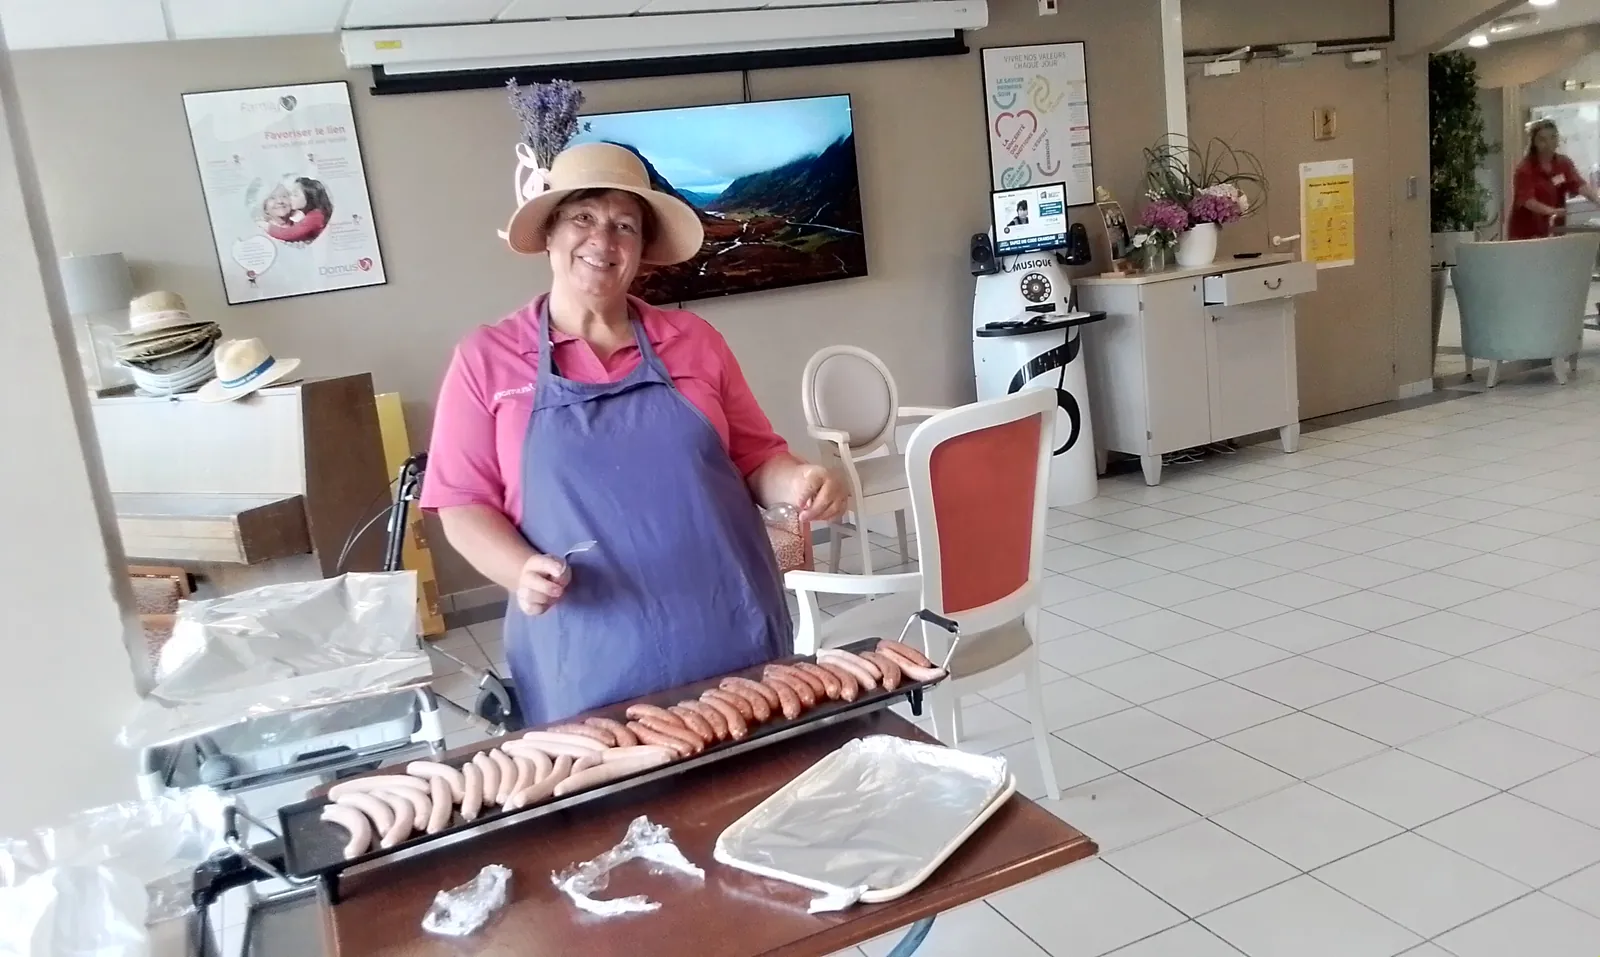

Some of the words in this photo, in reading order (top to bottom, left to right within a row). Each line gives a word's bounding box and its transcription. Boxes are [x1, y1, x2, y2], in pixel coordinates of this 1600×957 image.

[1004, 54, 1023, 63] VIVRE
[1039, 52, 1066, 60] VALEURS
[1014, 61, 1039, 69] CHAQUE
[264, 130, 312, 140] Favoriser
[314, 127, 324, 136] le
[326, 125, 346, 135] lien
[319, 263, 358, 276] Domus
[1013, 259, 1052, 272] MUSIQUE
